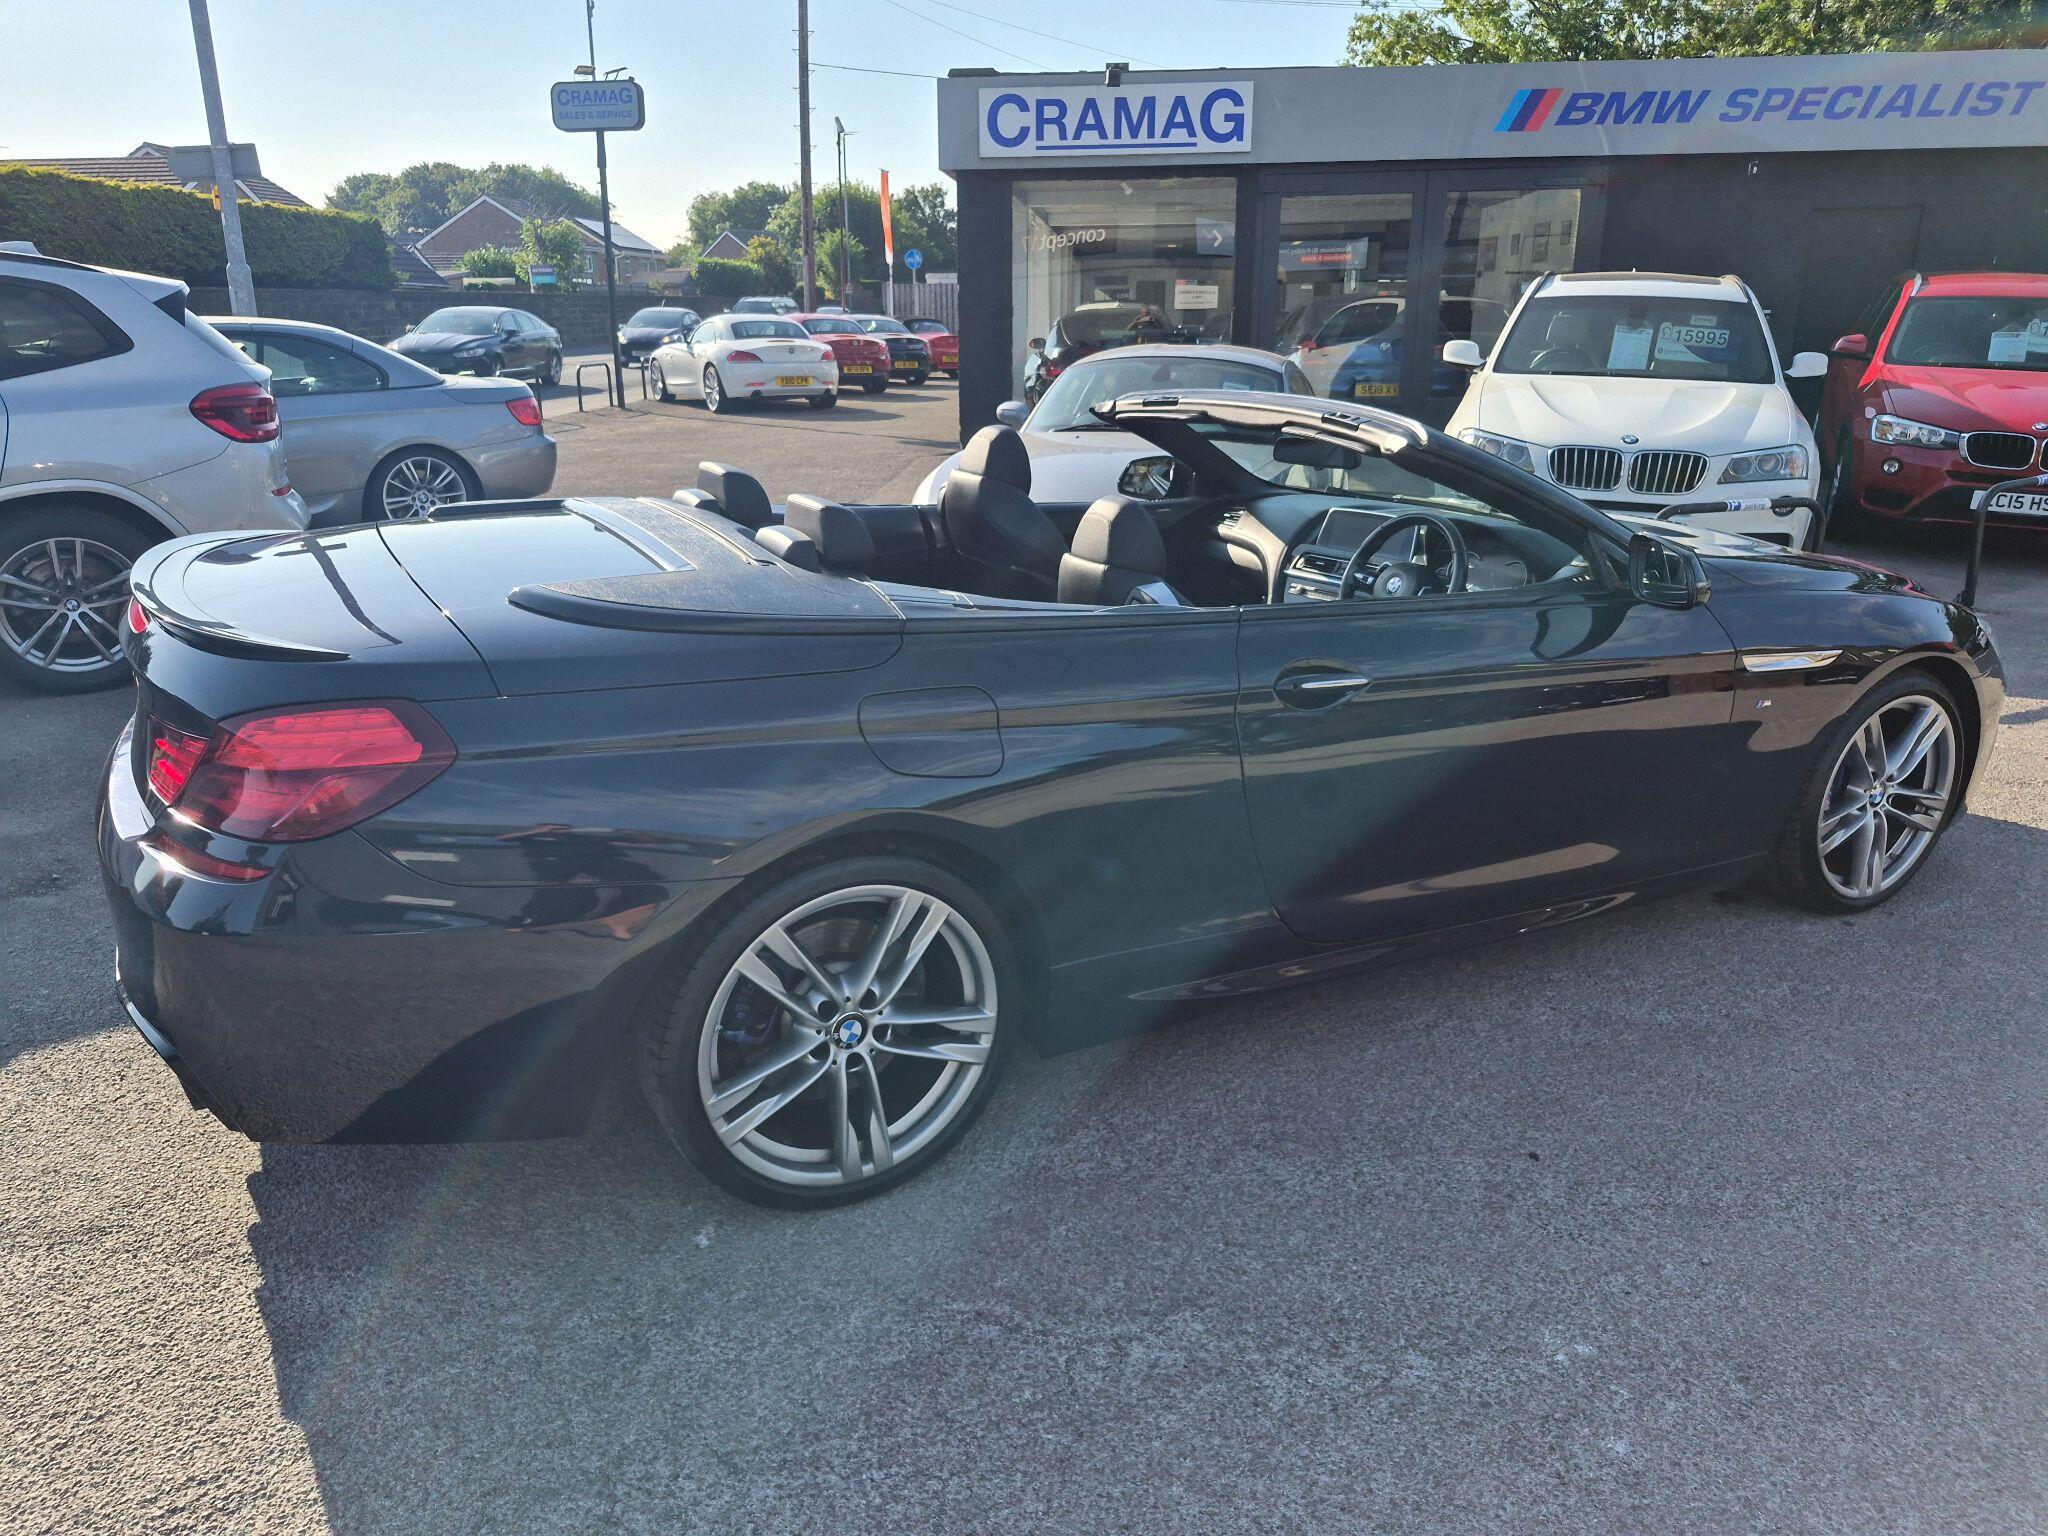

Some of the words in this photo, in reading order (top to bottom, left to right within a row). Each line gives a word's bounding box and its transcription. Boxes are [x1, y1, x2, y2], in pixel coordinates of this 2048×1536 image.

[557, 87, 633, 106] CRAMAG
[1554, 89, 1713, 126] BMW
[1718, 80, 2048, 123] SPECIALIST
[558, 111, 586, 120] SALES
[587, 111, 594, 119] &
[596, 110, 633, 119] SERVICE
[986, 88, 1245, 148] CRAMAG
[1744, 500, 1766, 511] parking
[1989, 494, 2025, 510] C15
